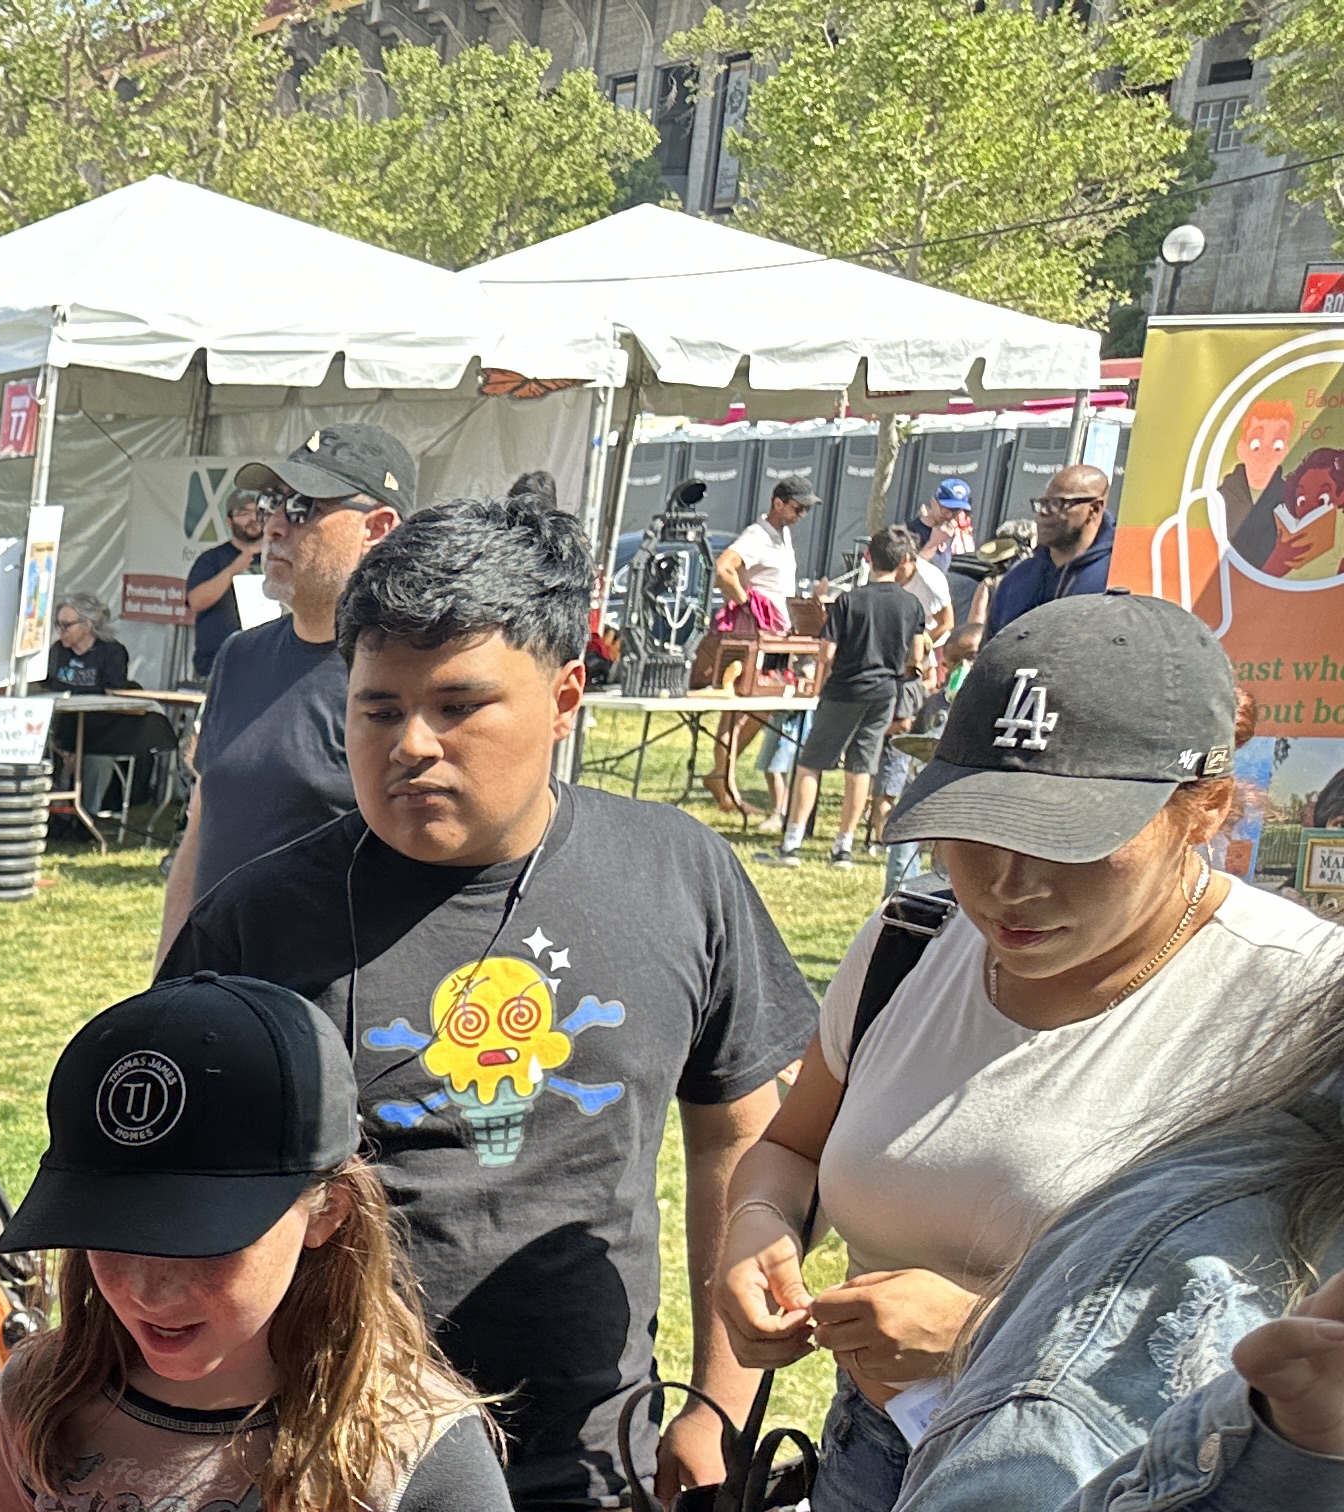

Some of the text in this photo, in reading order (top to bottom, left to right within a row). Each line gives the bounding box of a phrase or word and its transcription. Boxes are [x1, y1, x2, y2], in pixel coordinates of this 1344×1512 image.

[1233, 657, 1284, 681] ast
[993, 668, 1059, 751] LA
[108, 1056, 178, 1086] THOMAS JAMES
[122, 1082, 152, 1122] TJ
[115, 1127, 154, 1141] HOMES
